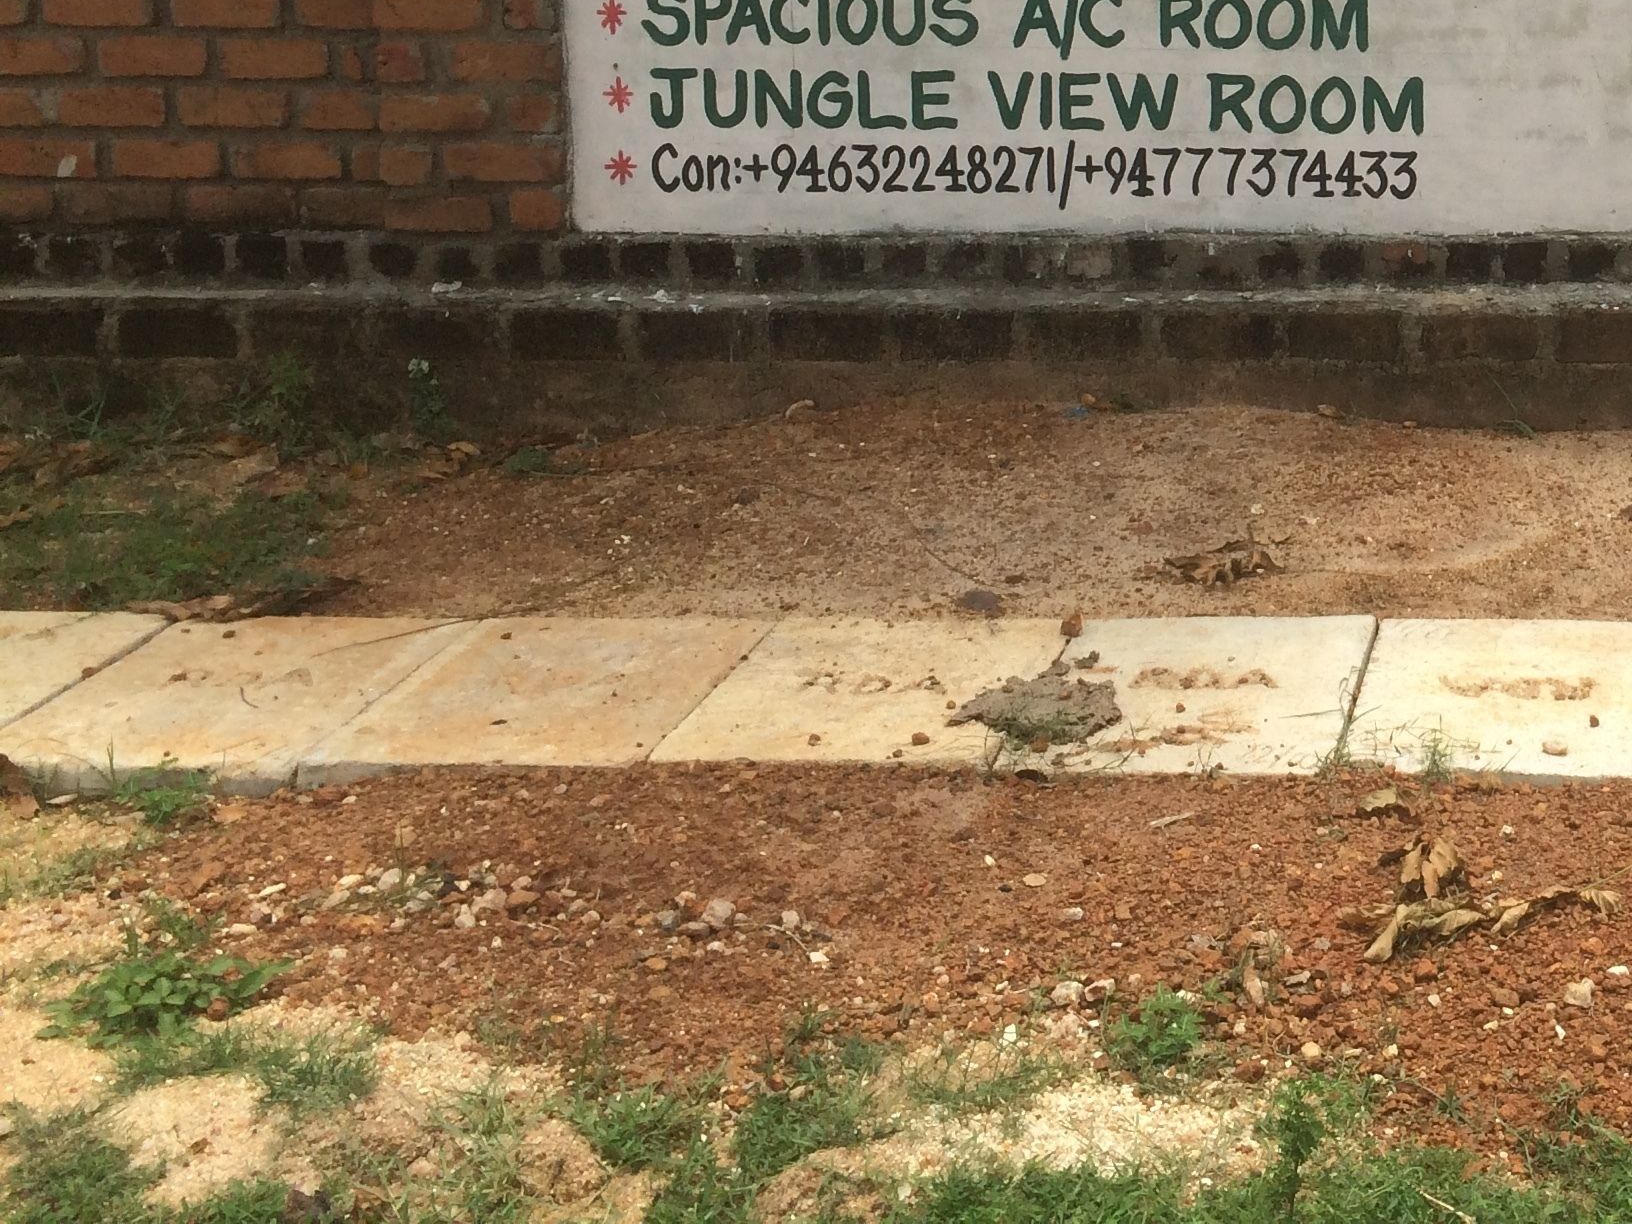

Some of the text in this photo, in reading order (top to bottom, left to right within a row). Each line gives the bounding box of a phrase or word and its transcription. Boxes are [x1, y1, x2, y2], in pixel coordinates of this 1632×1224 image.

[650, 68, 1424, 135] JUNGLE VIEW ROOM
